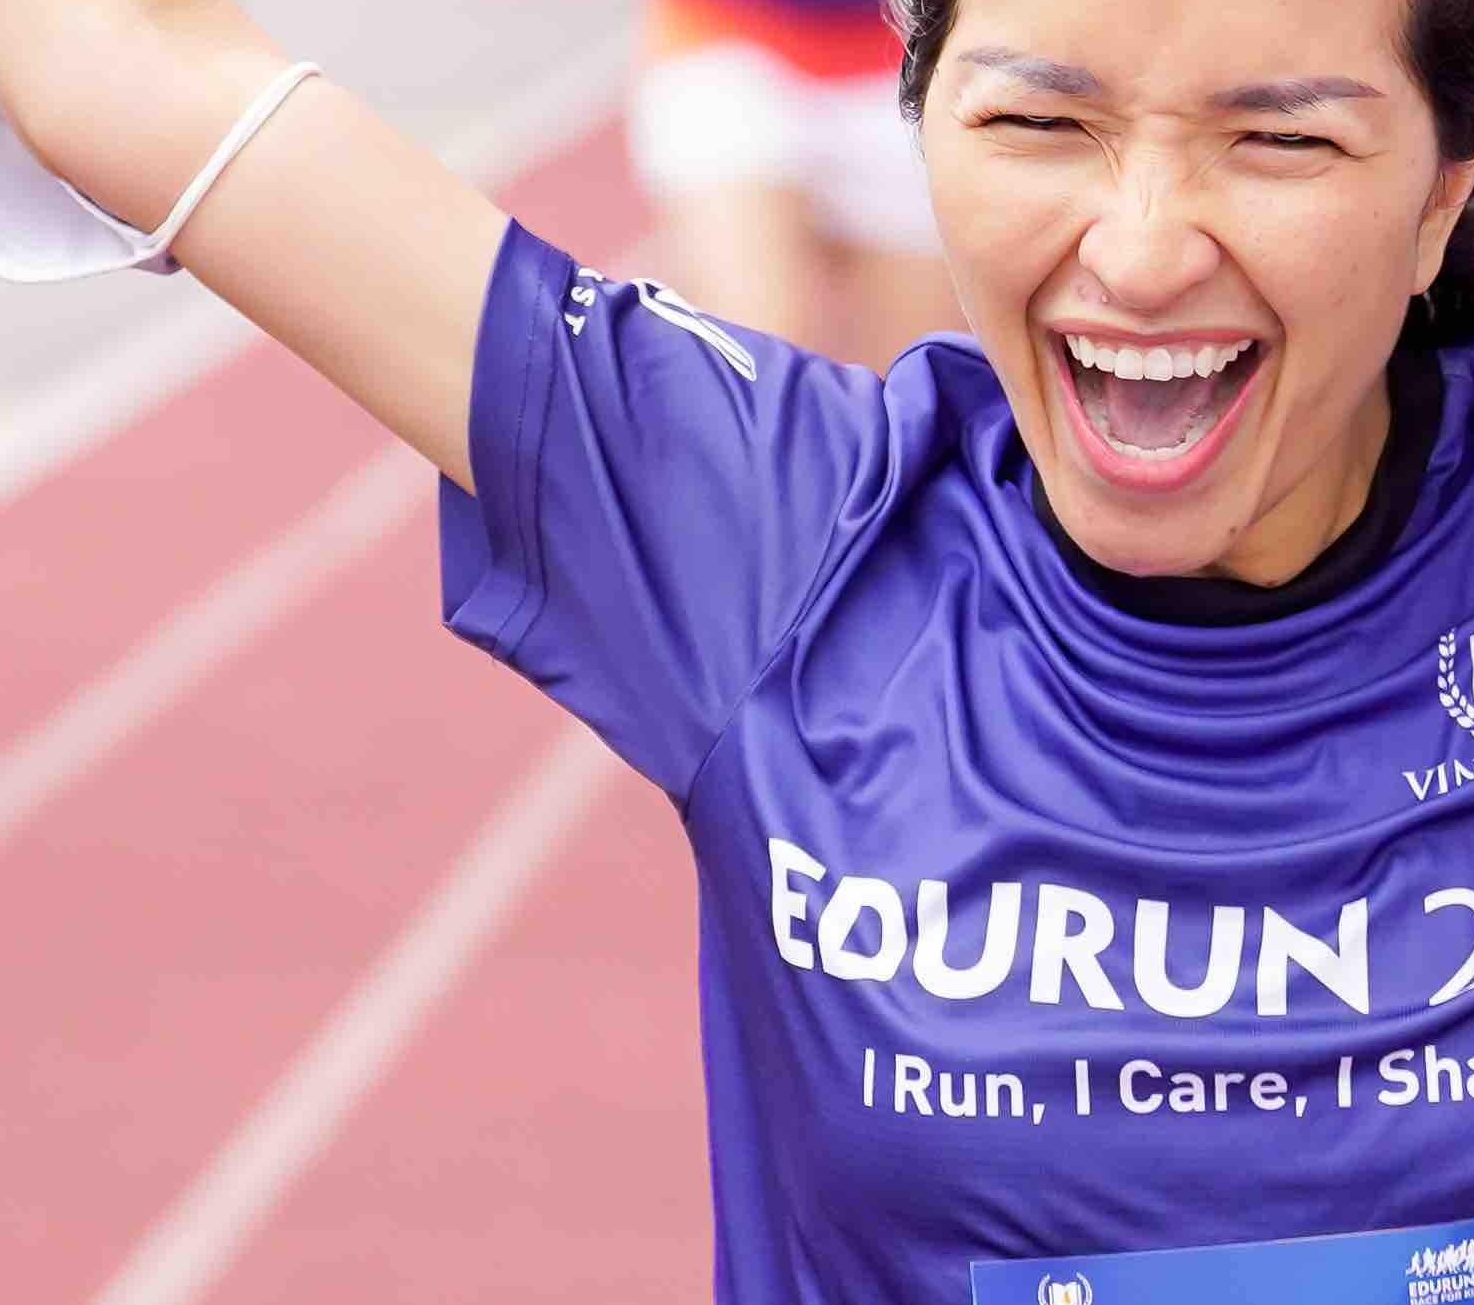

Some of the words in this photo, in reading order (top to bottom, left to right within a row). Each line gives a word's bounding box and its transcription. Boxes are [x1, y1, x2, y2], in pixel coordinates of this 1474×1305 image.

[768, 837, 1370, 1018] EDURUN
[863, 1048, 875, 1108] I
[894, 1053, 1045, 1125] Run,
[1075, 1059, 1091, 1115] I
[1119, 1059, 1308, 1118] Care,
[1337, 1056, 1353, 1108] I
